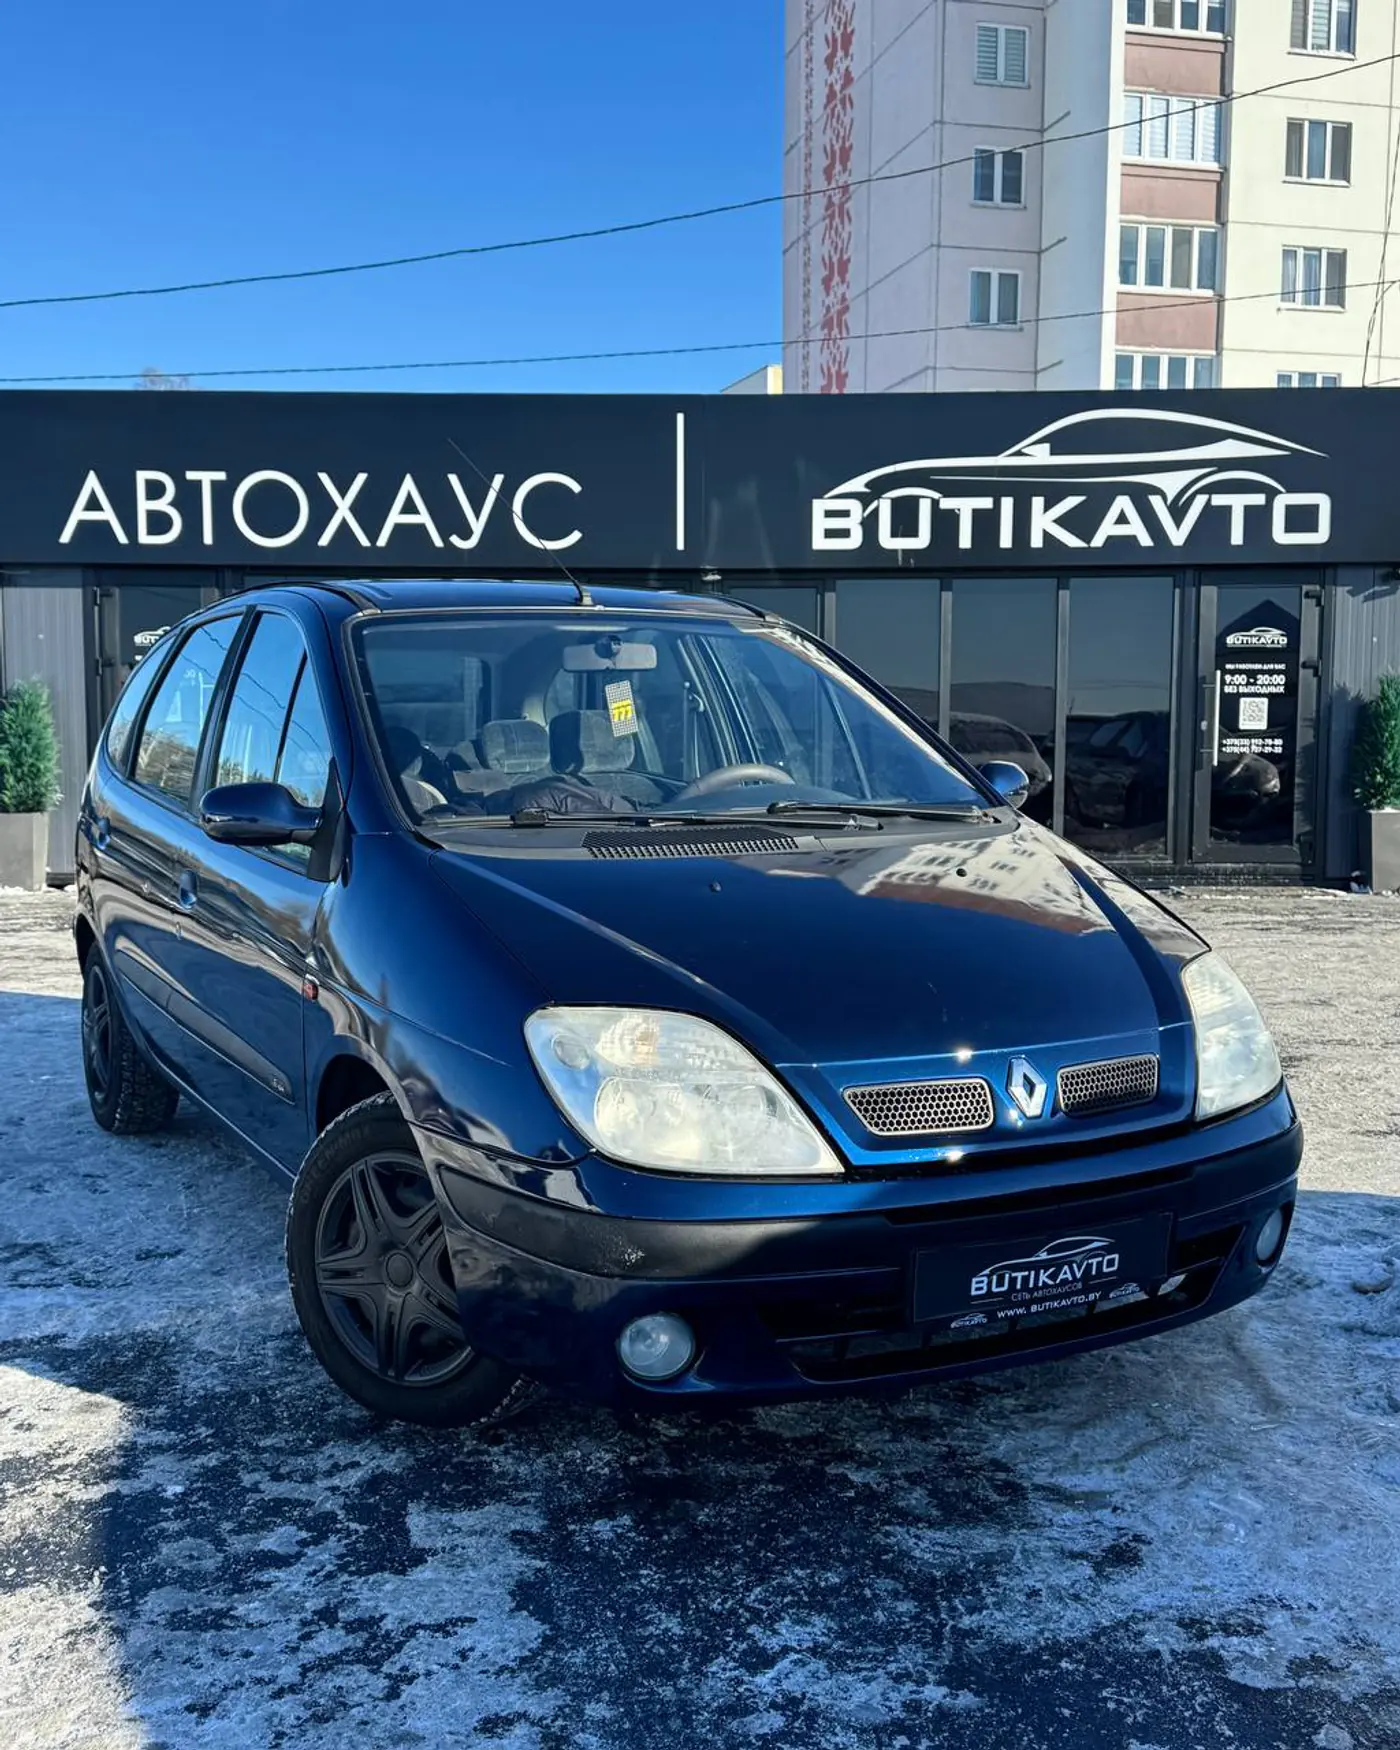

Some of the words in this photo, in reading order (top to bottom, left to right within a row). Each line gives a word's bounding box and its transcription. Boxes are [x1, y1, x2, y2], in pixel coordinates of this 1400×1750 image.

[58, 470, 583, 550] АВТОХАУС
[811, 492, 1332, 551] BUTIKAVTO
[1224, 674, 1247, 684] 9:00
[1256, 674, 1286, 684] 20:00
[970, 1253, 1120, 1296] BUTIKAVTO
